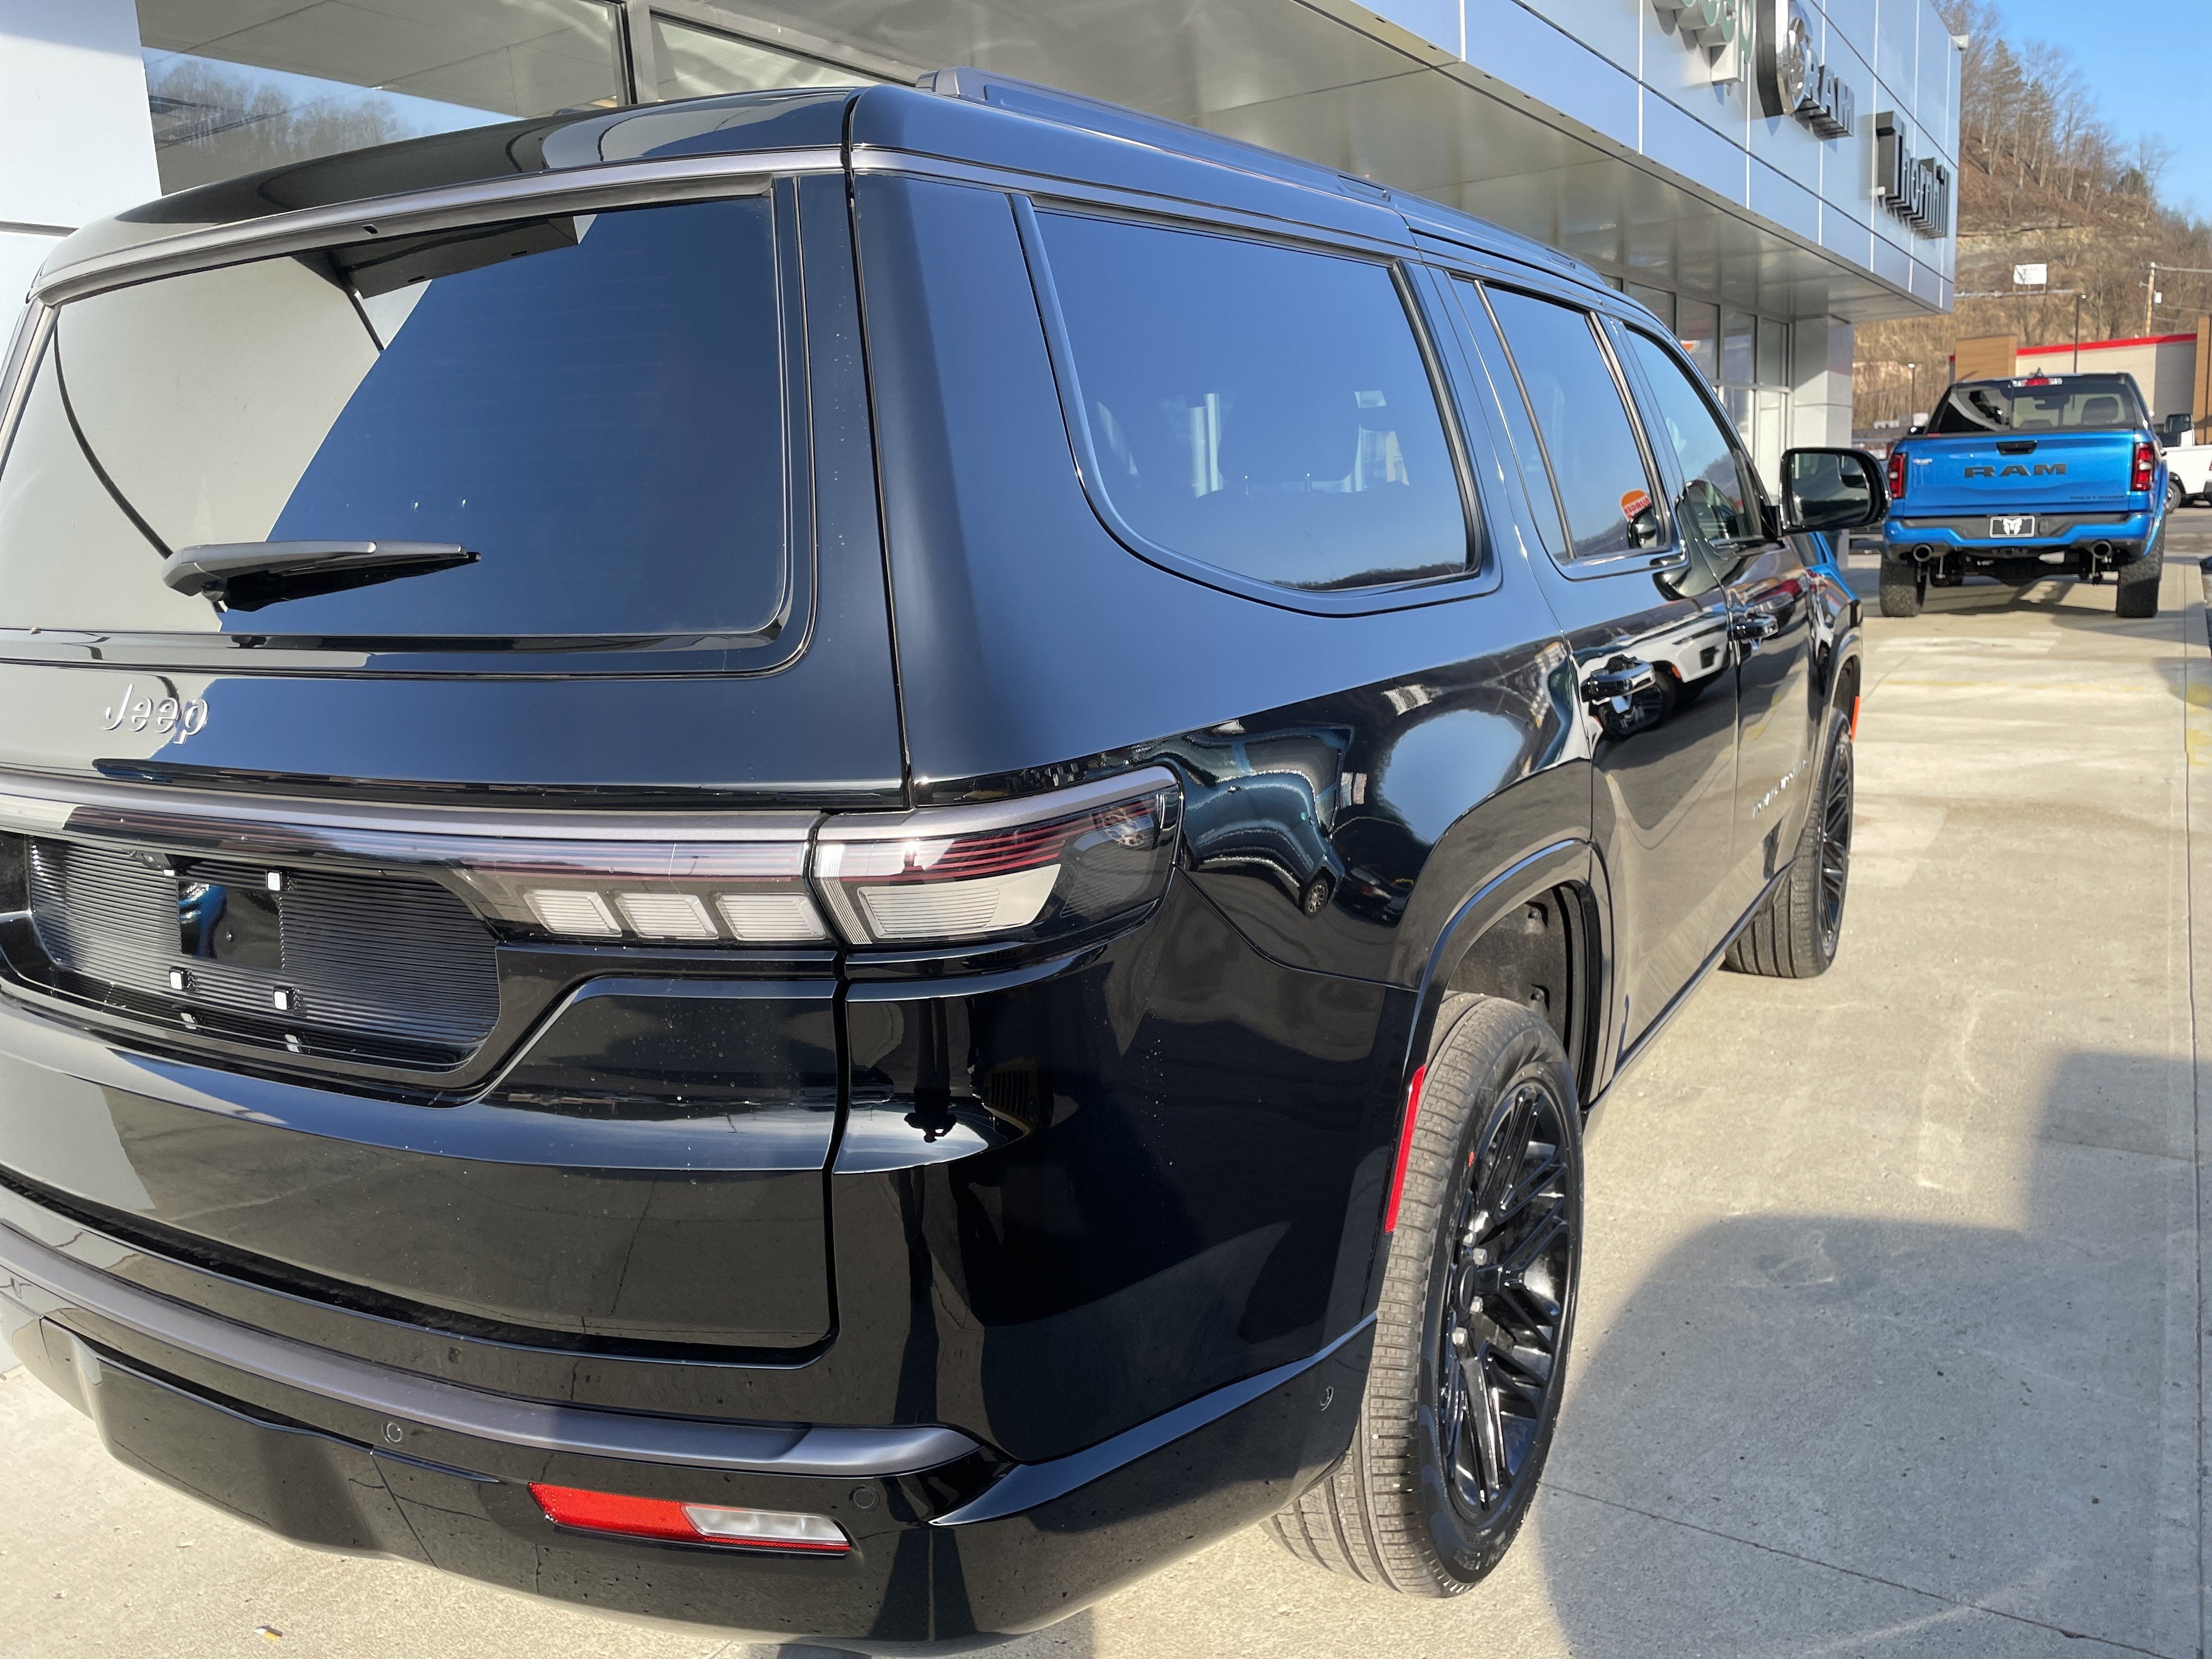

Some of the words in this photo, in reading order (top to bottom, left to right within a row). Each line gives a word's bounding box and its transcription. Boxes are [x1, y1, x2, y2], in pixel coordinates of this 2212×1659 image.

[1803, 48, 1855, 137] RAM
[1964, 463, 2067, 478] RAM
[101, 683, 209, 745] Jeep
